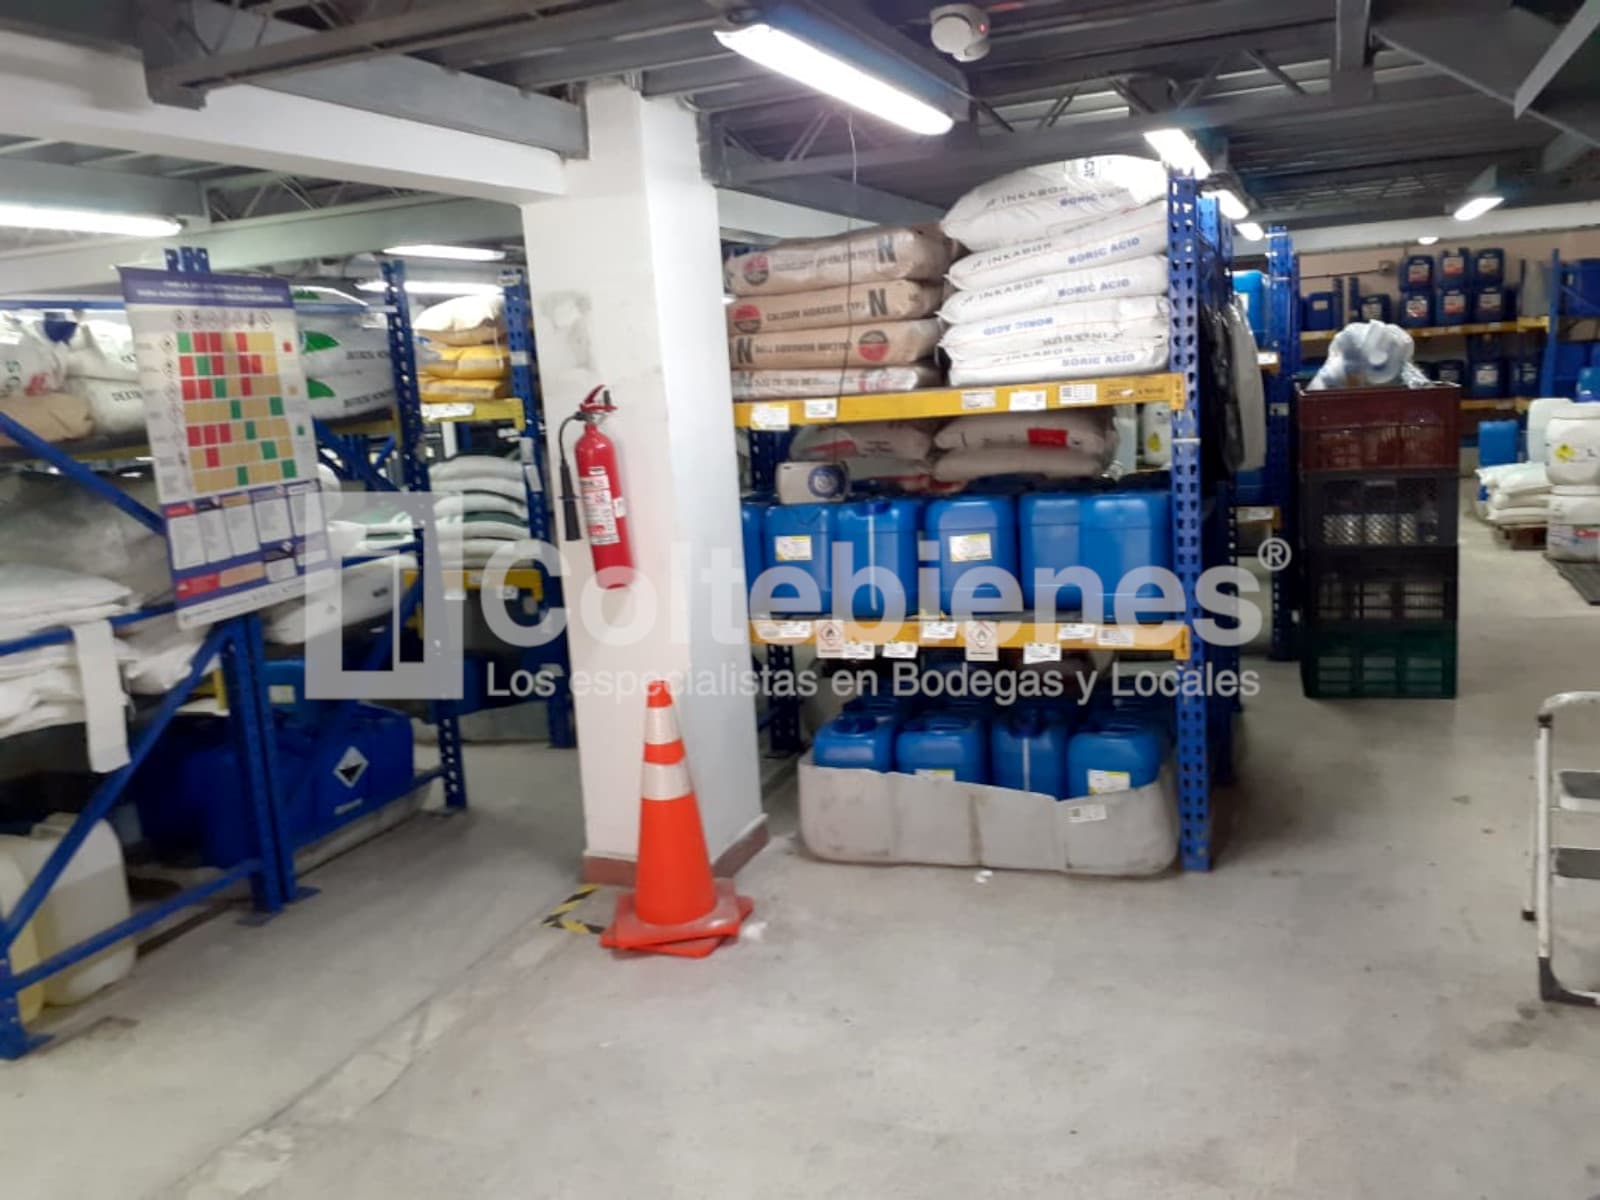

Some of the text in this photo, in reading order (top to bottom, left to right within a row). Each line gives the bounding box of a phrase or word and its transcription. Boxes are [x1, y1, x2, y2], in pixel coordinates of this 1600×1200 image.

[1068, 236, 1140, 265] BORIC ACID
[1057, 278, 1130, 297] BORIC ACID
[868, 289, 888, 318] N
[736, 338, 754, 364] N
[1061, 353, 1136, 367] BORIC ACID
